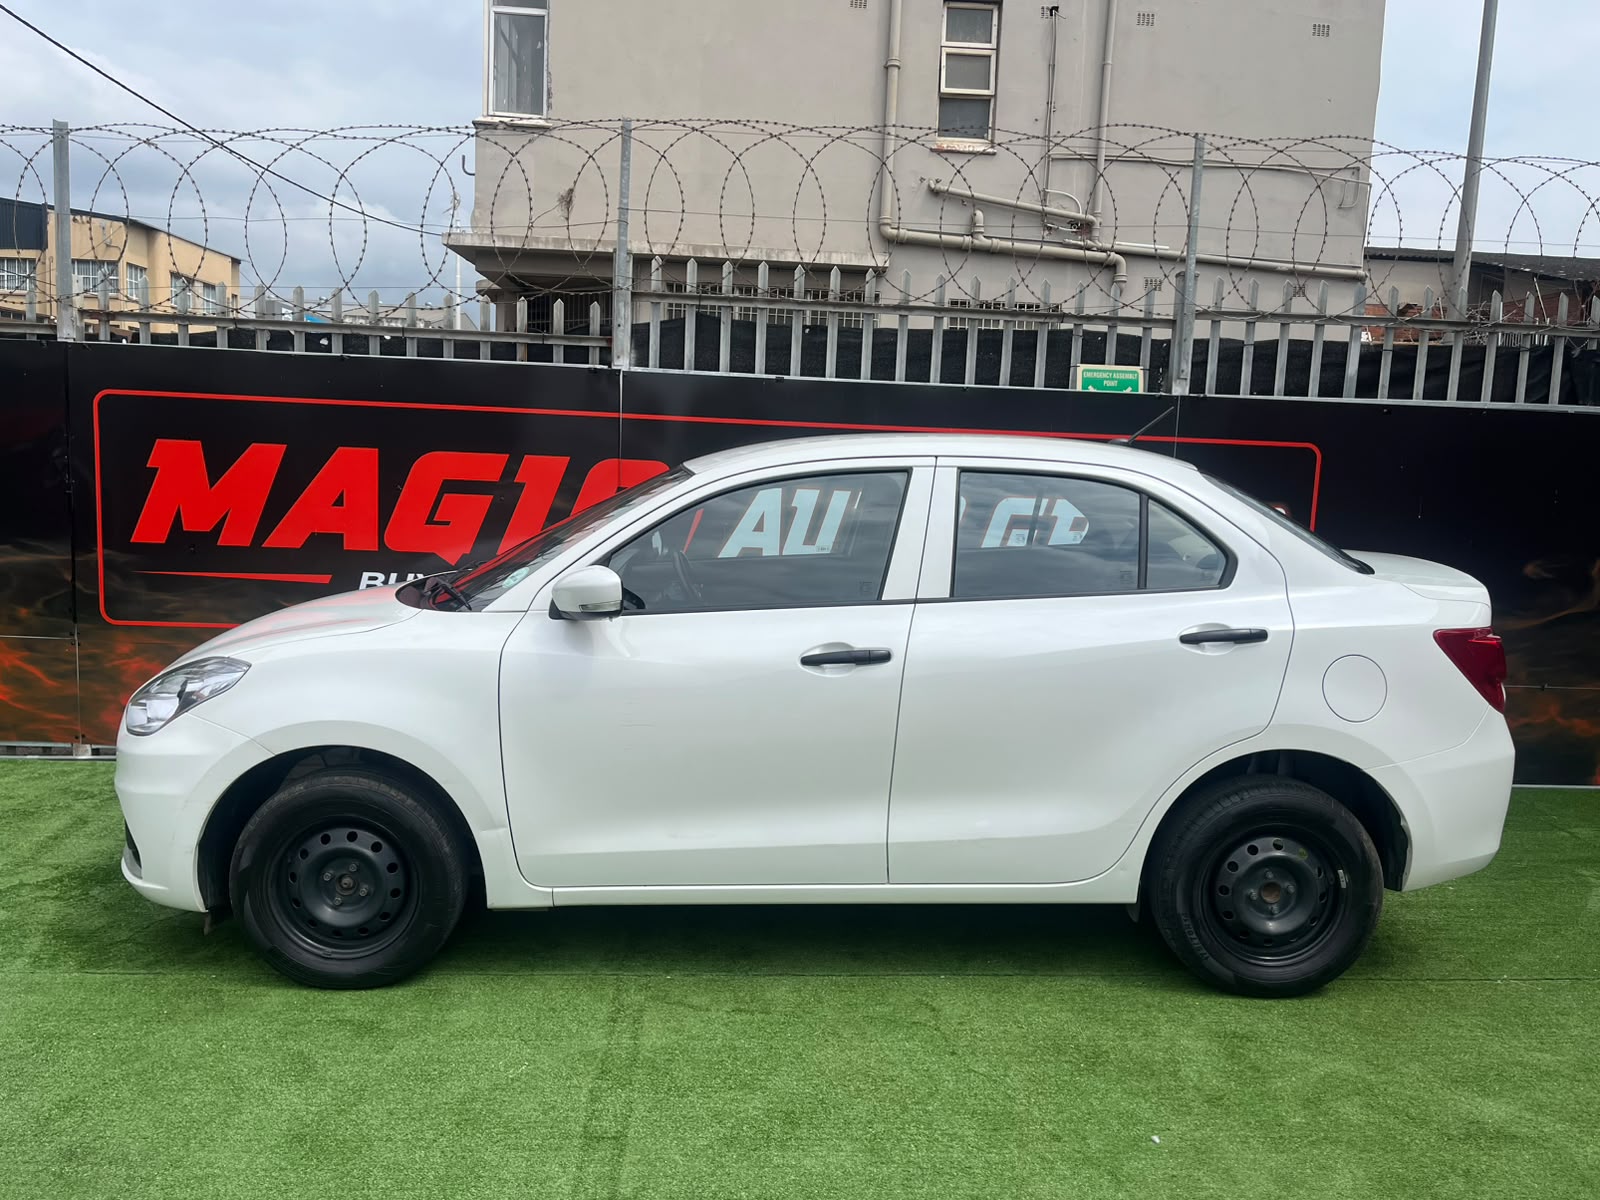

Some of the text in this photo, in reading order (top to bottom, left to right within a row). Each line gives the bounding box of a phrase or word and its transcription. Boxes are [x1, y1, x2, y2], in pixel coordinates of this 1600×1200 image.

[1083, 371, 1138, 380] EMERGENCY ASSEMBLY
[717, 486, 866, 558] AU
